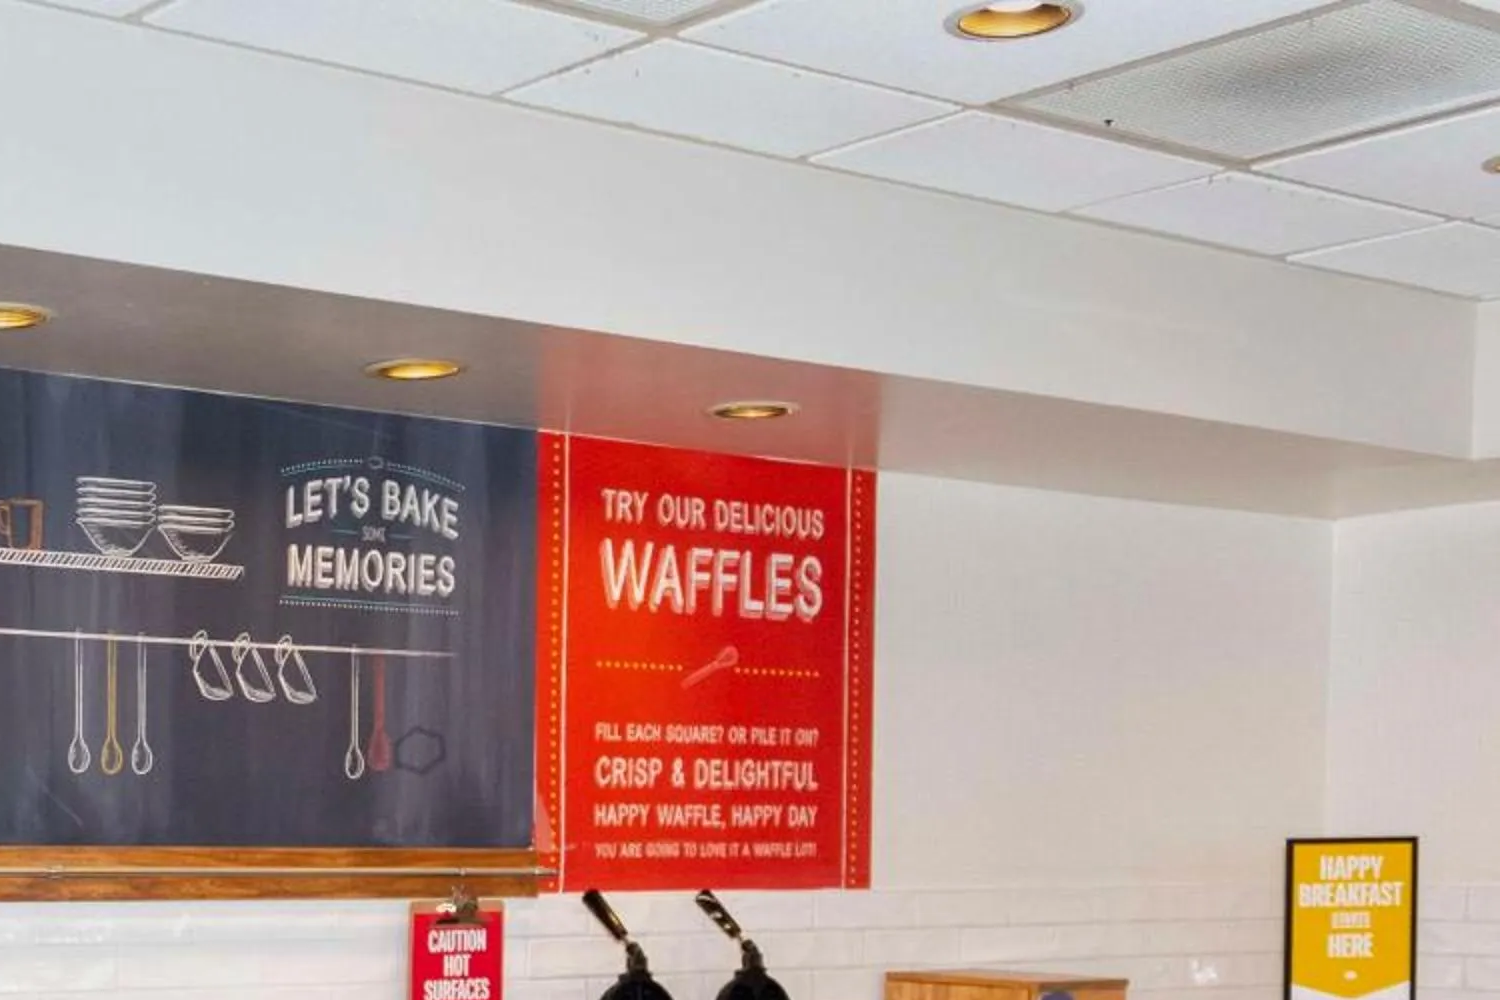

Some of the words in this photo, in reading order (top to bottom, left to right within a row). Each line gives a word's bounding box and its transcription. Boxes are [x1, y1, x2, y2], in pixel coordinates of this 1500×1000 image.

[285, 475, 370, 528] LET'S
[381, 479, 459, 540] BAKE
[602, 488, 649, 523] TRY
[658, 493, 706, 529] OUR
[713, 500, 825, 540] DELICIOUS
[287, 544, 456, 597] MEMORIES
[601, 537, 824, 624] WAFFLES
[594, 721, 622, 742] FILL
[626, 723, 662, 743] EACH
[665, 724, 725, 744] SQUARE?
[728, 725, 747, 745] OR
[750, 726, 777, 746] PILE
[779, 727, 793, 746] IT
[794, 727, 820, 747] ON?
[594, 756, 663, 788] CRISP
[671, 757, 686, 787] &
[693, 758, 819, 791] DELIGHTFUL
[594, 803, 651, 826] HAPPY
[656, 804, 727, 830] WAFFLE,
[731, 804, 783, 828] HAPPY
[788, 805, 818, 828] DAY
[595, 842, 617, 859] YOU
[619, 842, 643, 859] ARE
[683, 842, 698, 859] TO
[741, 842, 751, 859] A
[753, 842, 793, 859] WAFFLE
[1319, 855, 1384, 880] HAPPY
[1298, 882, 1404, 908] BREAKFAST
[427, 928, 488, 953] CAUTION
[1327, 932, 1375, 958] HERE
[443, 954, 472, 977] HOT
